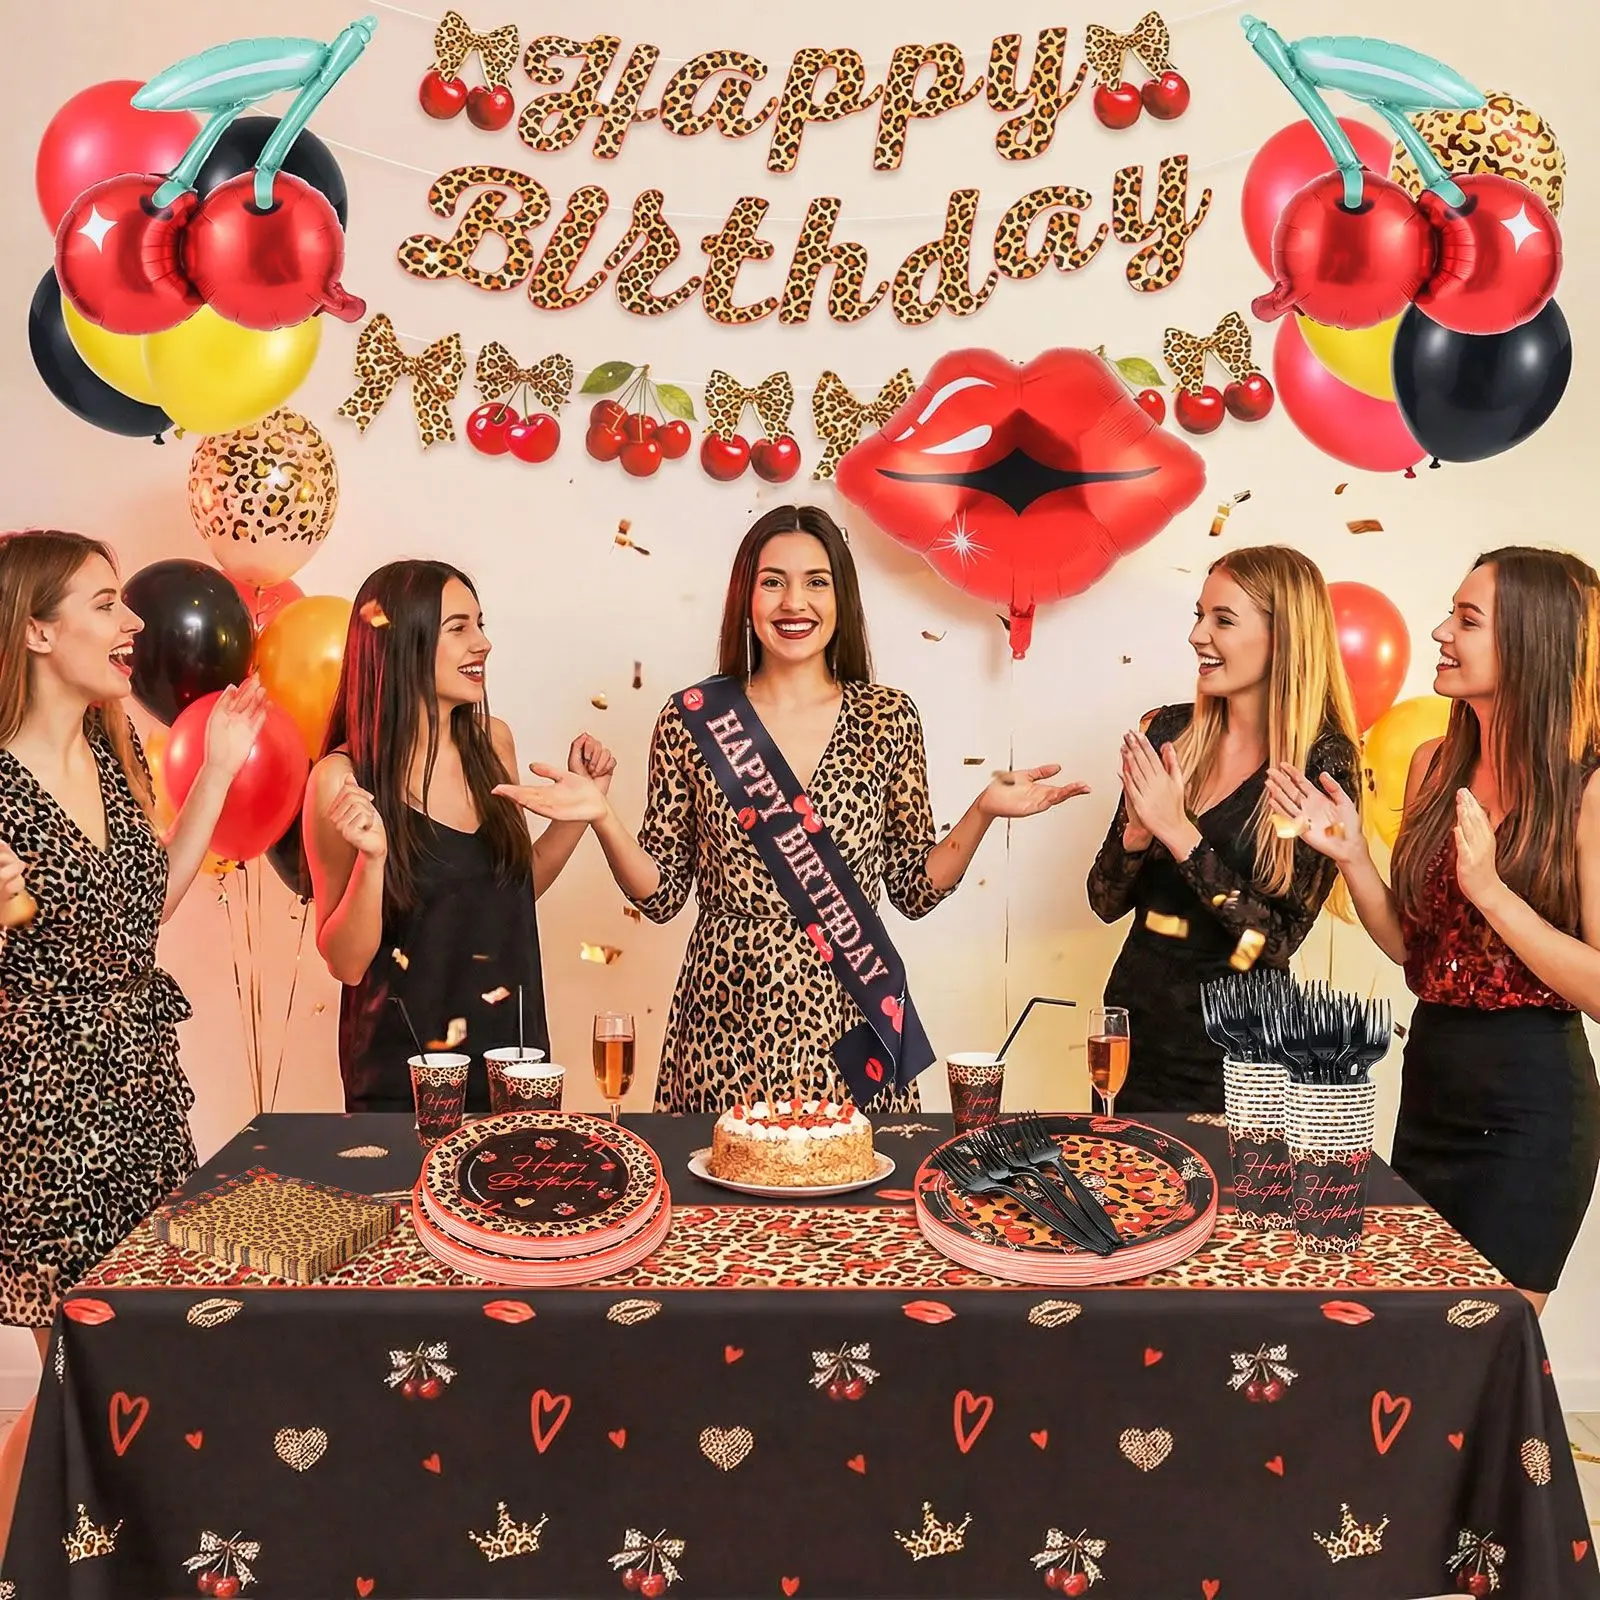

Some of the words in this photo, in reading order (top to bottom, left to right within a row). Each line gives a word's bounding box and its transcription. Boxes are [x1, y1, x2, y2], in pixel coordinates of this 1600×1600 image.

[518, 27, 1087, 173] Happy
[397, 154, 1213, 326] Birthday
[707, 709, 793, 823] HAPPY
[773, 823, 888, 986] BIRTHDAY
[511, 1154, 589, 1173] Happy
[1243, 1152, 1291, 1179] Happ
[487, 1172, 599, 1191] Birthday
[1233, 1174, 1293, 1204] Birthd
[1304, 1175, 1361, 1202] Happy
[1294, 1197, 1363, 1226] Birthday
